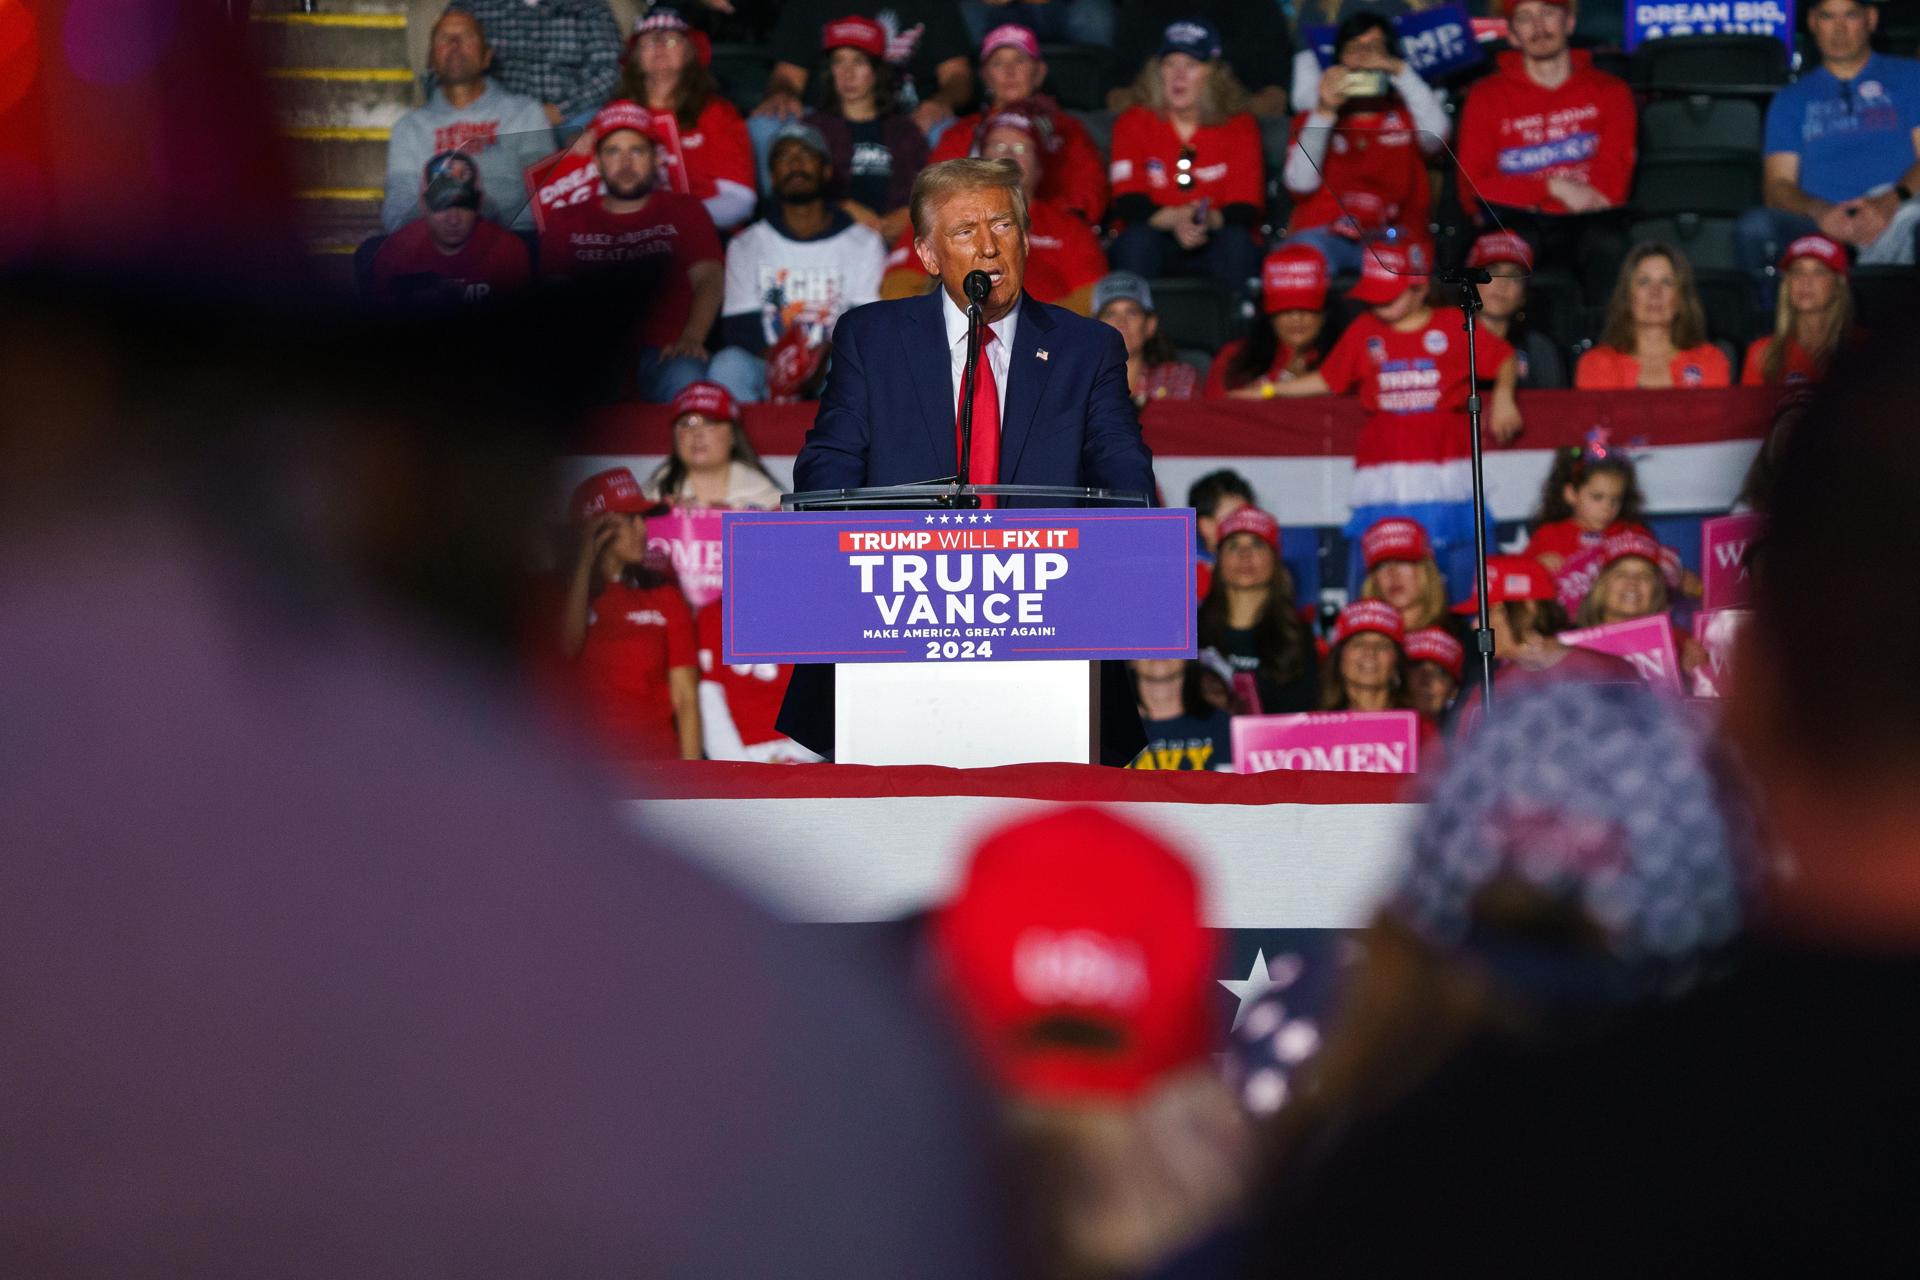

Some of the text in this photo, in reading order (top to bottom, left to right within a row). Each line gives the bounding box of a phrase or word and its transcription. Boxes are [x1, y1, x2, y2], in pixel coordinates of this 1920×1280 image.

[1637, 3, 1730, 24] DREAM
[540, 163, 600, 204] DREA
[648, 537, 721, 569] OME
[849, 530, 1069, 550] TRUMP WILL FIX IT
[849, 553, 1069, 593] TRUMP
[873, 592, 1044, 626] VANCE
[863, 626, 1056, 639] MAKE AMERICA GREAT AGAIN!
[926, 640, 993, 659] 2024
[1133, 746, 1213, 770] AVY
[1248, 742, 1407, 773] WOMEN
